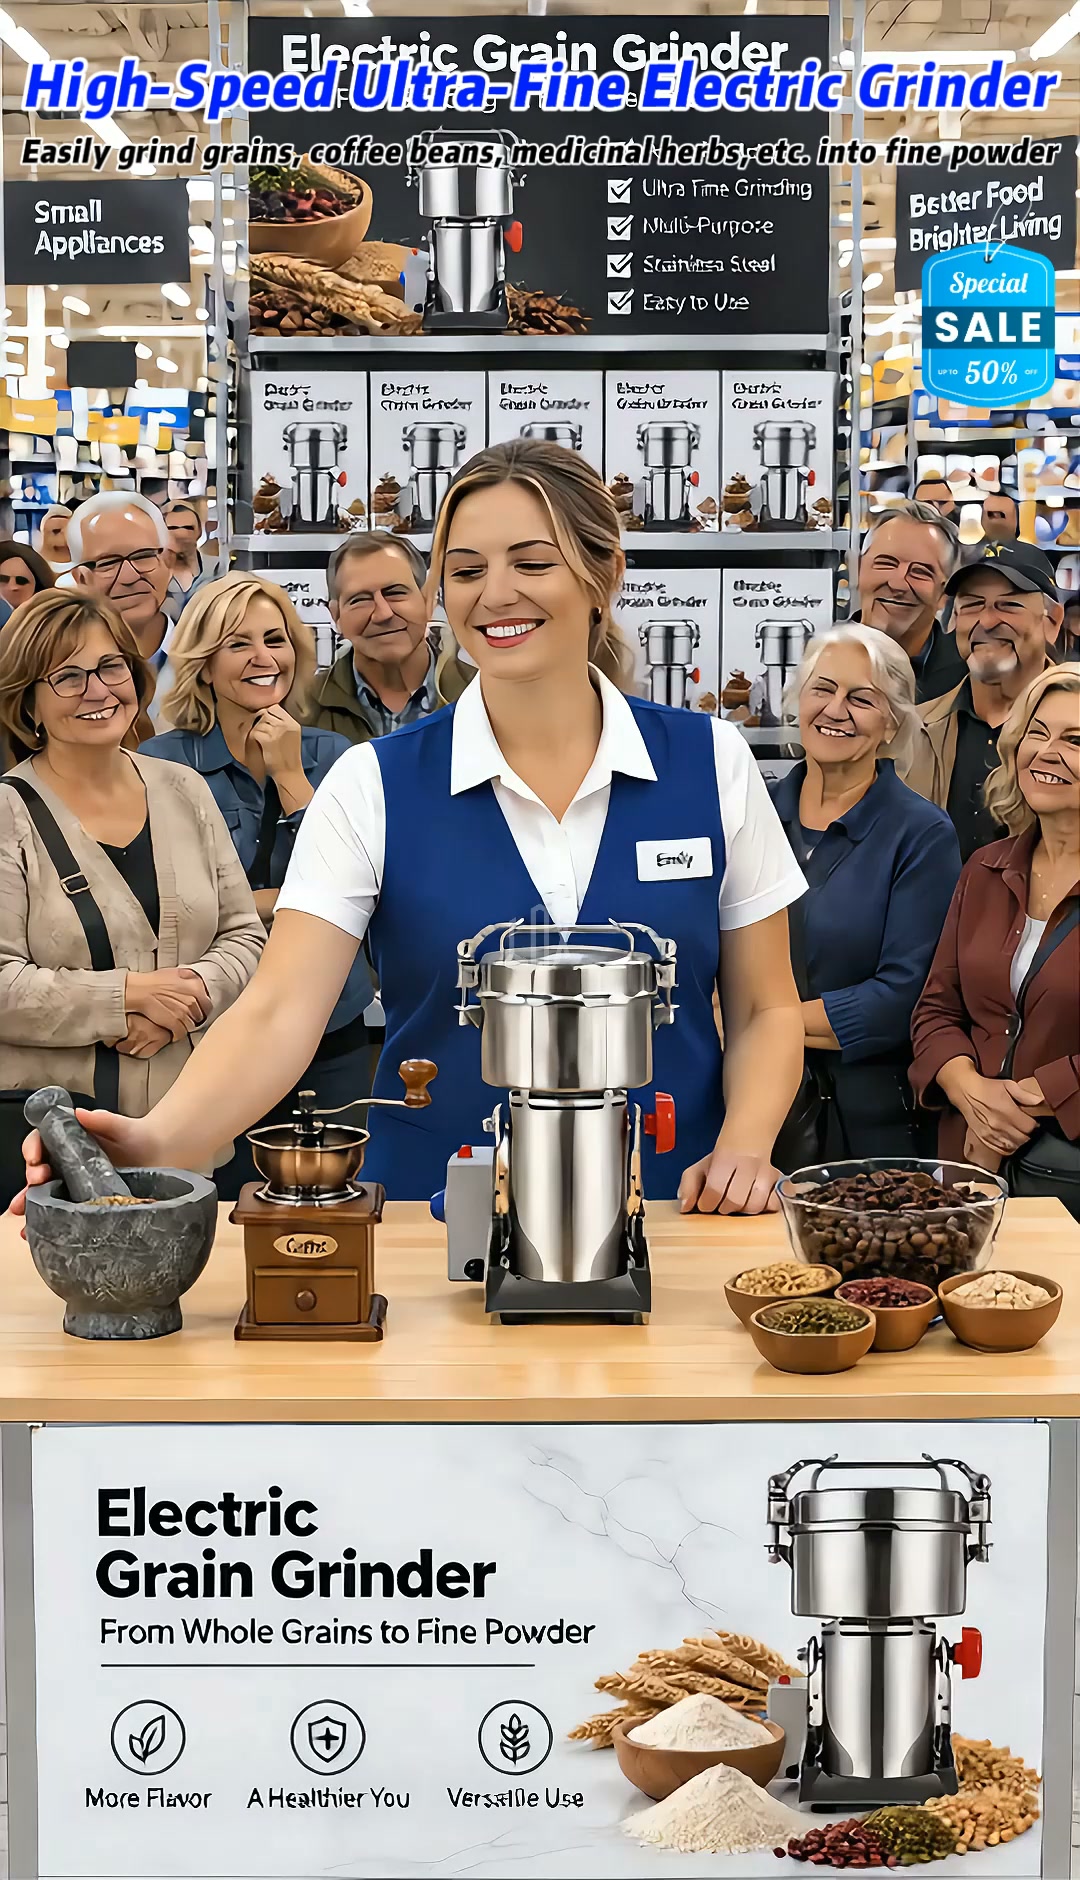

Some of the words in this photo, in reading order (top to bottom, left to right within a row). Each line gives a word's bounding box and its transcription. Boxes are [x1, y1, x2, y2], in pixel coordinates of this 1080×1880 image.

[282, 31, 459, 73] Electric
[473, 31, 598, 72] Grain
[612, 31, 788, 72] Grinder
[986, 175, 1044, 209] Food
[34, 198, 102, 224] Small
[34, 229, 165, 261] Appliances
[97, 1485, 319, 1538] Electric
[95, 1547, 254, 1599] Grain
[271, 1547, 497, 1599] Grinder
[100, 1618, 175, 1645] From
[181, 1618, 274, 1645] Whole
[281, 1618, 373, 1645] Grains
[380, 1619, 410, 1645] to
[417, 1617, 478, 1645] Fine
[485, 1618, 596, 1645] Powder
[85, 1787, 140, 1809] More
[147, 1787, 213, 1809] Flavor
[246, 1787, 265, 1809] A
[268, 1787, 368, 1809] Healthier
[370, 1787, 411, 1809] You
[545, 1787, 585, 1809] Use
